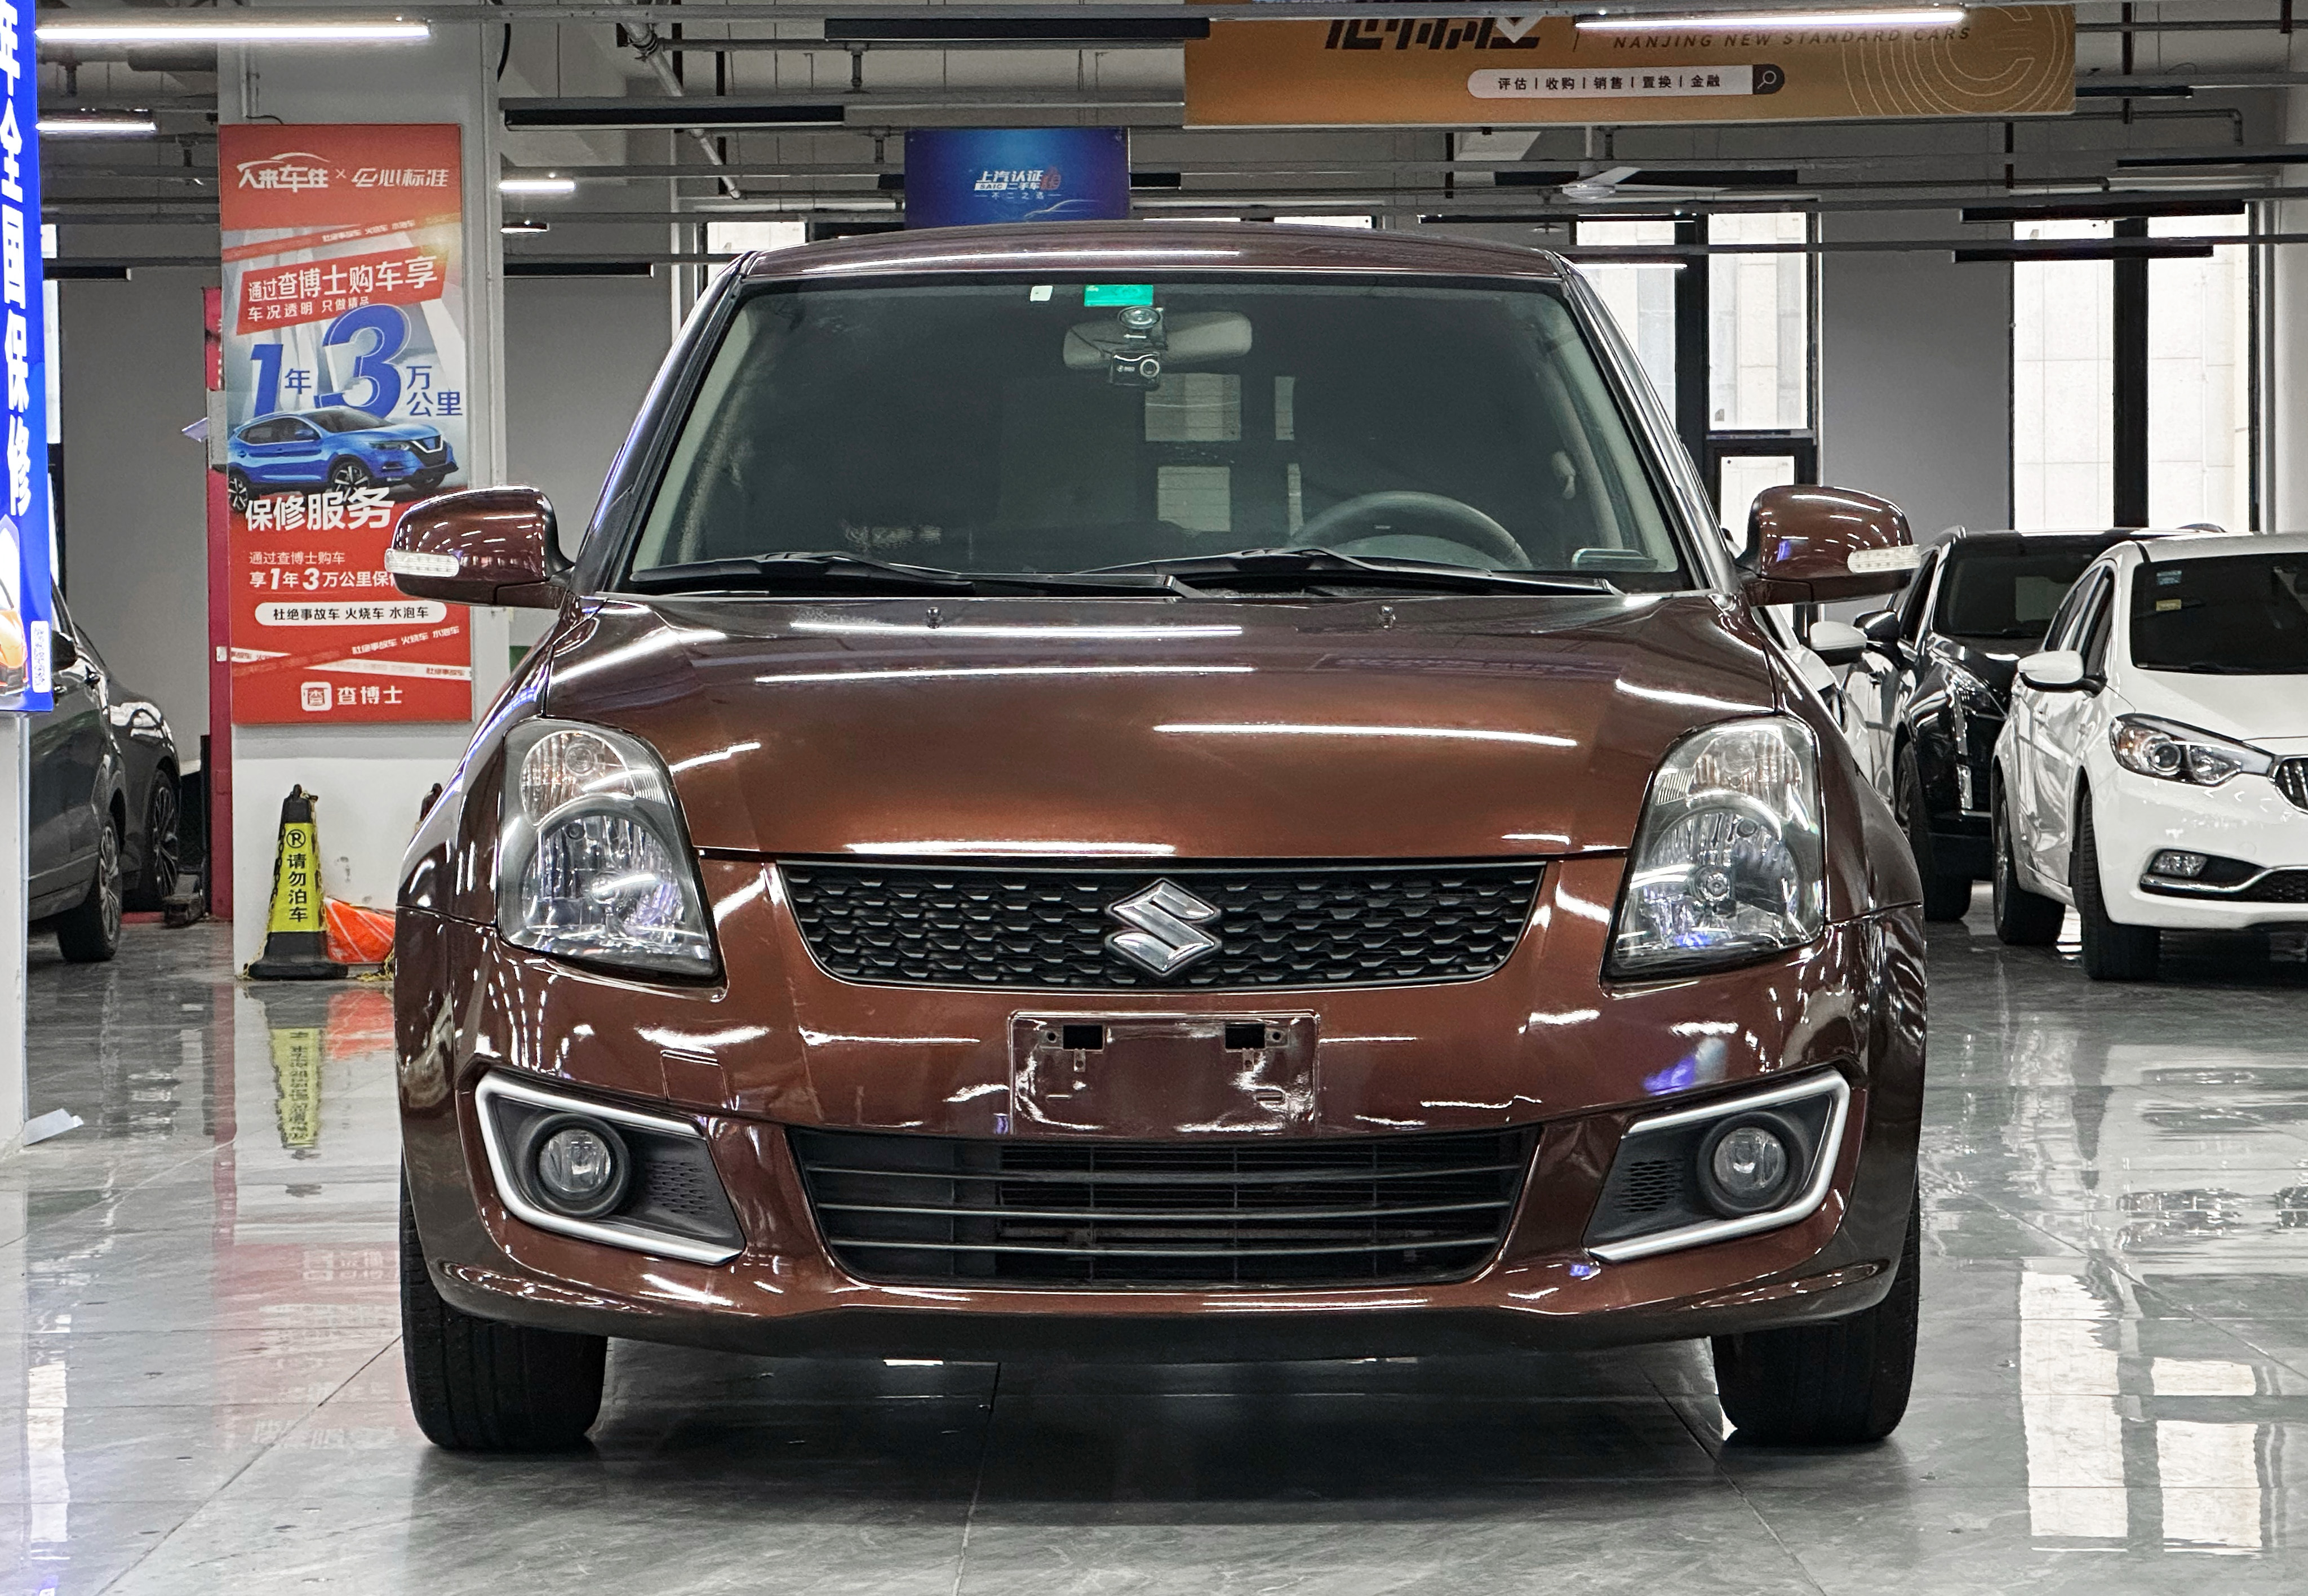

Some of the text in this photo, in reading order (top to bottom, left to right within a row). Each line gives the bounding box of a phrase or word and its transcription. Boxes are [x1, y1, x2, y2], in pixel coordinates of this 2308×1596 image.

[1613, 28, 1970, 48] NANJING NEW STANDARD CARS
[1498, 74, 1720, 90] 评估 收购 销售 置换 金融
[976, 170, 1044, 183] 上汽认证
[248, 255, 437, 303] 通过查博士购车享
[247, 301, 313, 322] 车况透明
[245, 487, 396, 531] 保修服务
[248, 552, 345, 565] 通过查博士购车
[273, 606, 429, 621] 杜绝事故车 火烧车 水泡车
[337, 686, 403, 705] 查博士
[286, 853, 308, 923] 请勿泊车
